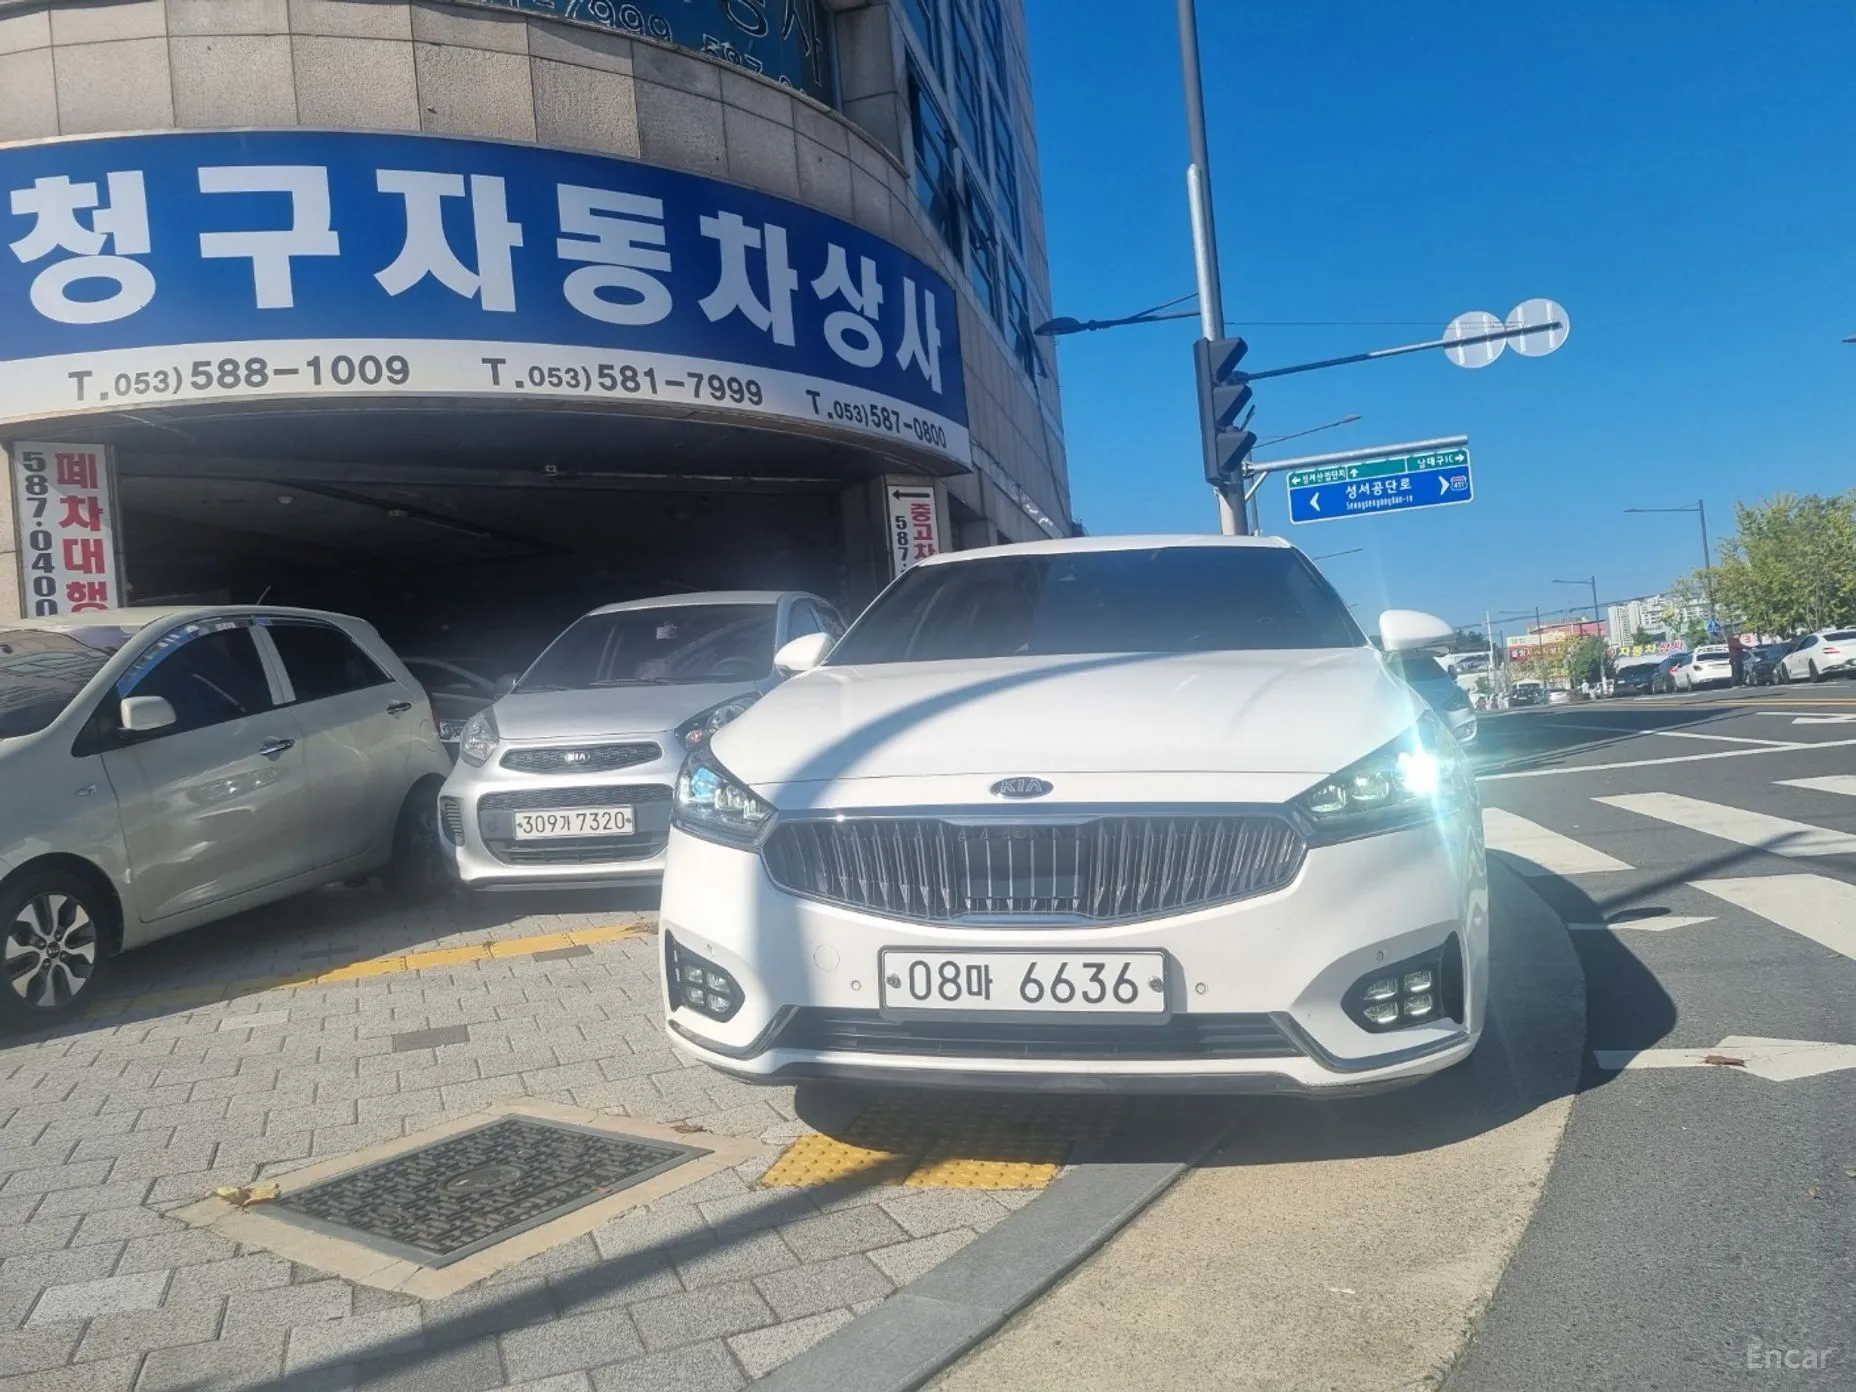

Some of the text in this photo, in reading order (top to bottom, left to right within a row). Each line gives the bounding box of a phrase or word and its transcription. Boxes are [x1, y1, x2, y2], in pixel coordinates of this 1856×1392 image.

[9, 165, 943, 395] 청구자동차상사
[1345, 478, 1412, 500] 성서공단로
[55, 452, 108, 613] 폐차대행
[576, 811, 626, 833] 7320
[908, 960, 1139, 1004] 08마 6636
